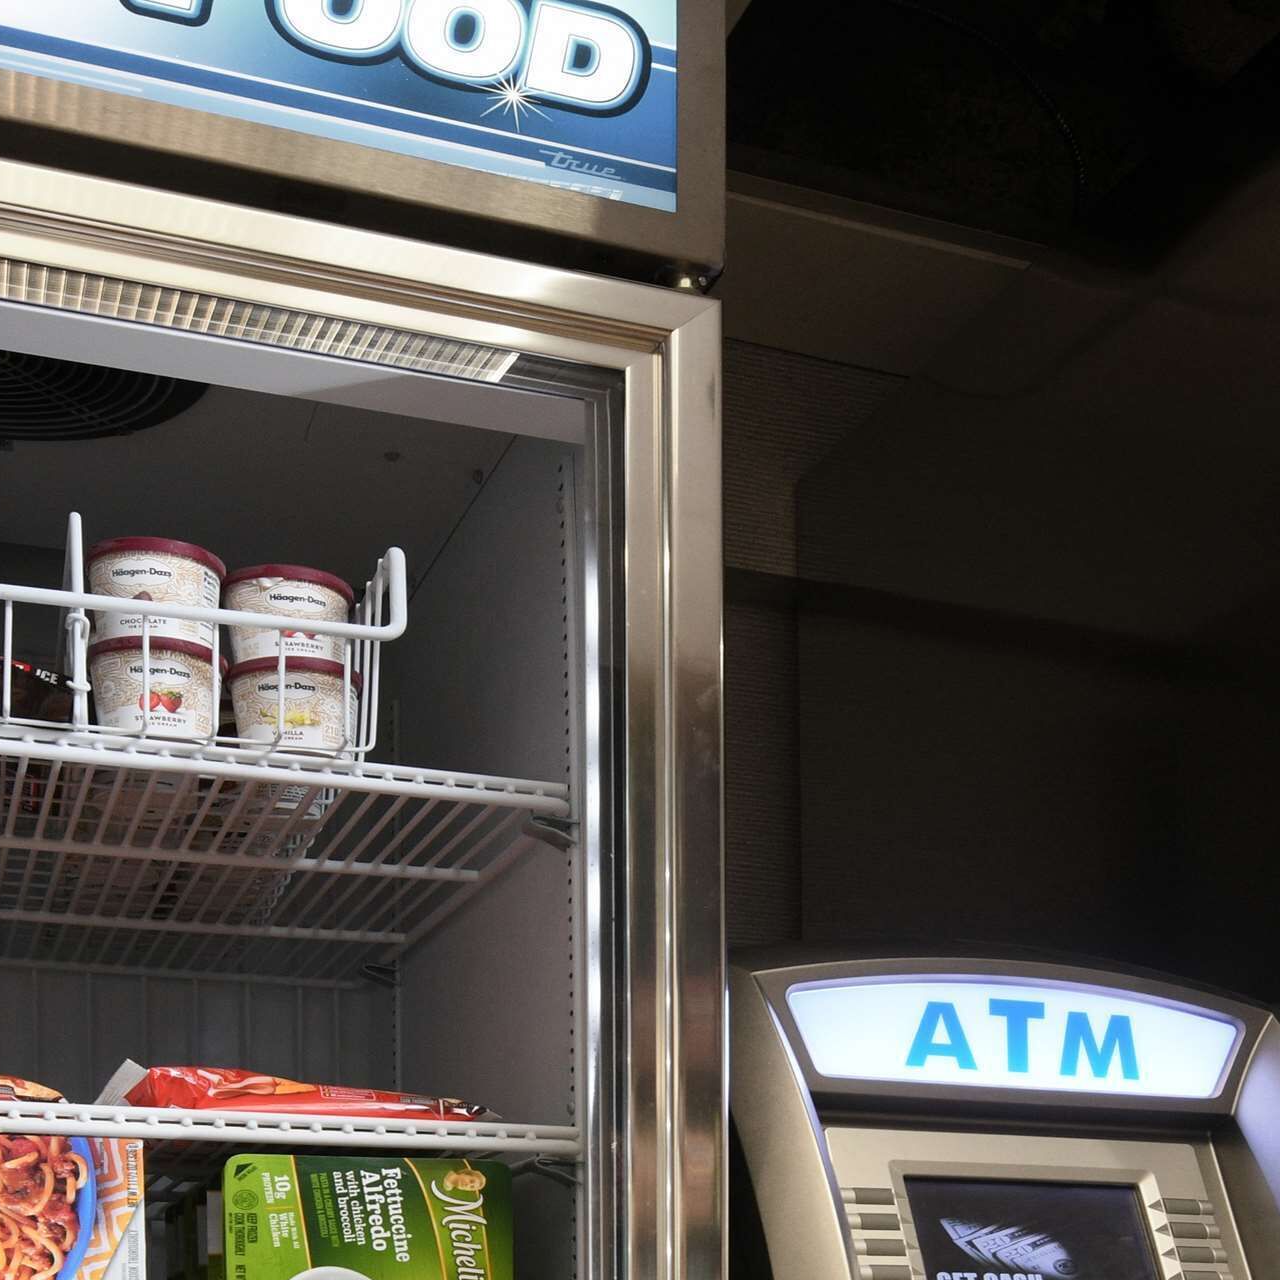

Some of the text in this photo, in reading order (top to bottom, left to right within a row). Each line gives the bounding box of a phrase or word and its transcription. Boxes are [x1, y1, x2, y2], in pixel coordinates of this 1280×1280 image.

[128, 0, 644, 111] OOD
[547, 151, 617, 177] true
[111, 566, 172, 579] Häagen-Dazs
[269, 592, 327, 608] Häagen-Dazs
[35, 668, 59, 685] ICE
[904, 998, 1141, 1082] ATM
[261, 1172, 274, 1203] PROTEIN
[273, 1174, 291, 1200] 10g
[333, 1171, 355, 1242] and broccoli
[345, 1170, 366, 1245] with chicken
[360, 1170, 387, 1252] Alfredo
[381, 1167, 411, 1262] Fettuccine
[268, 1213, 281, 1247] Chicken
